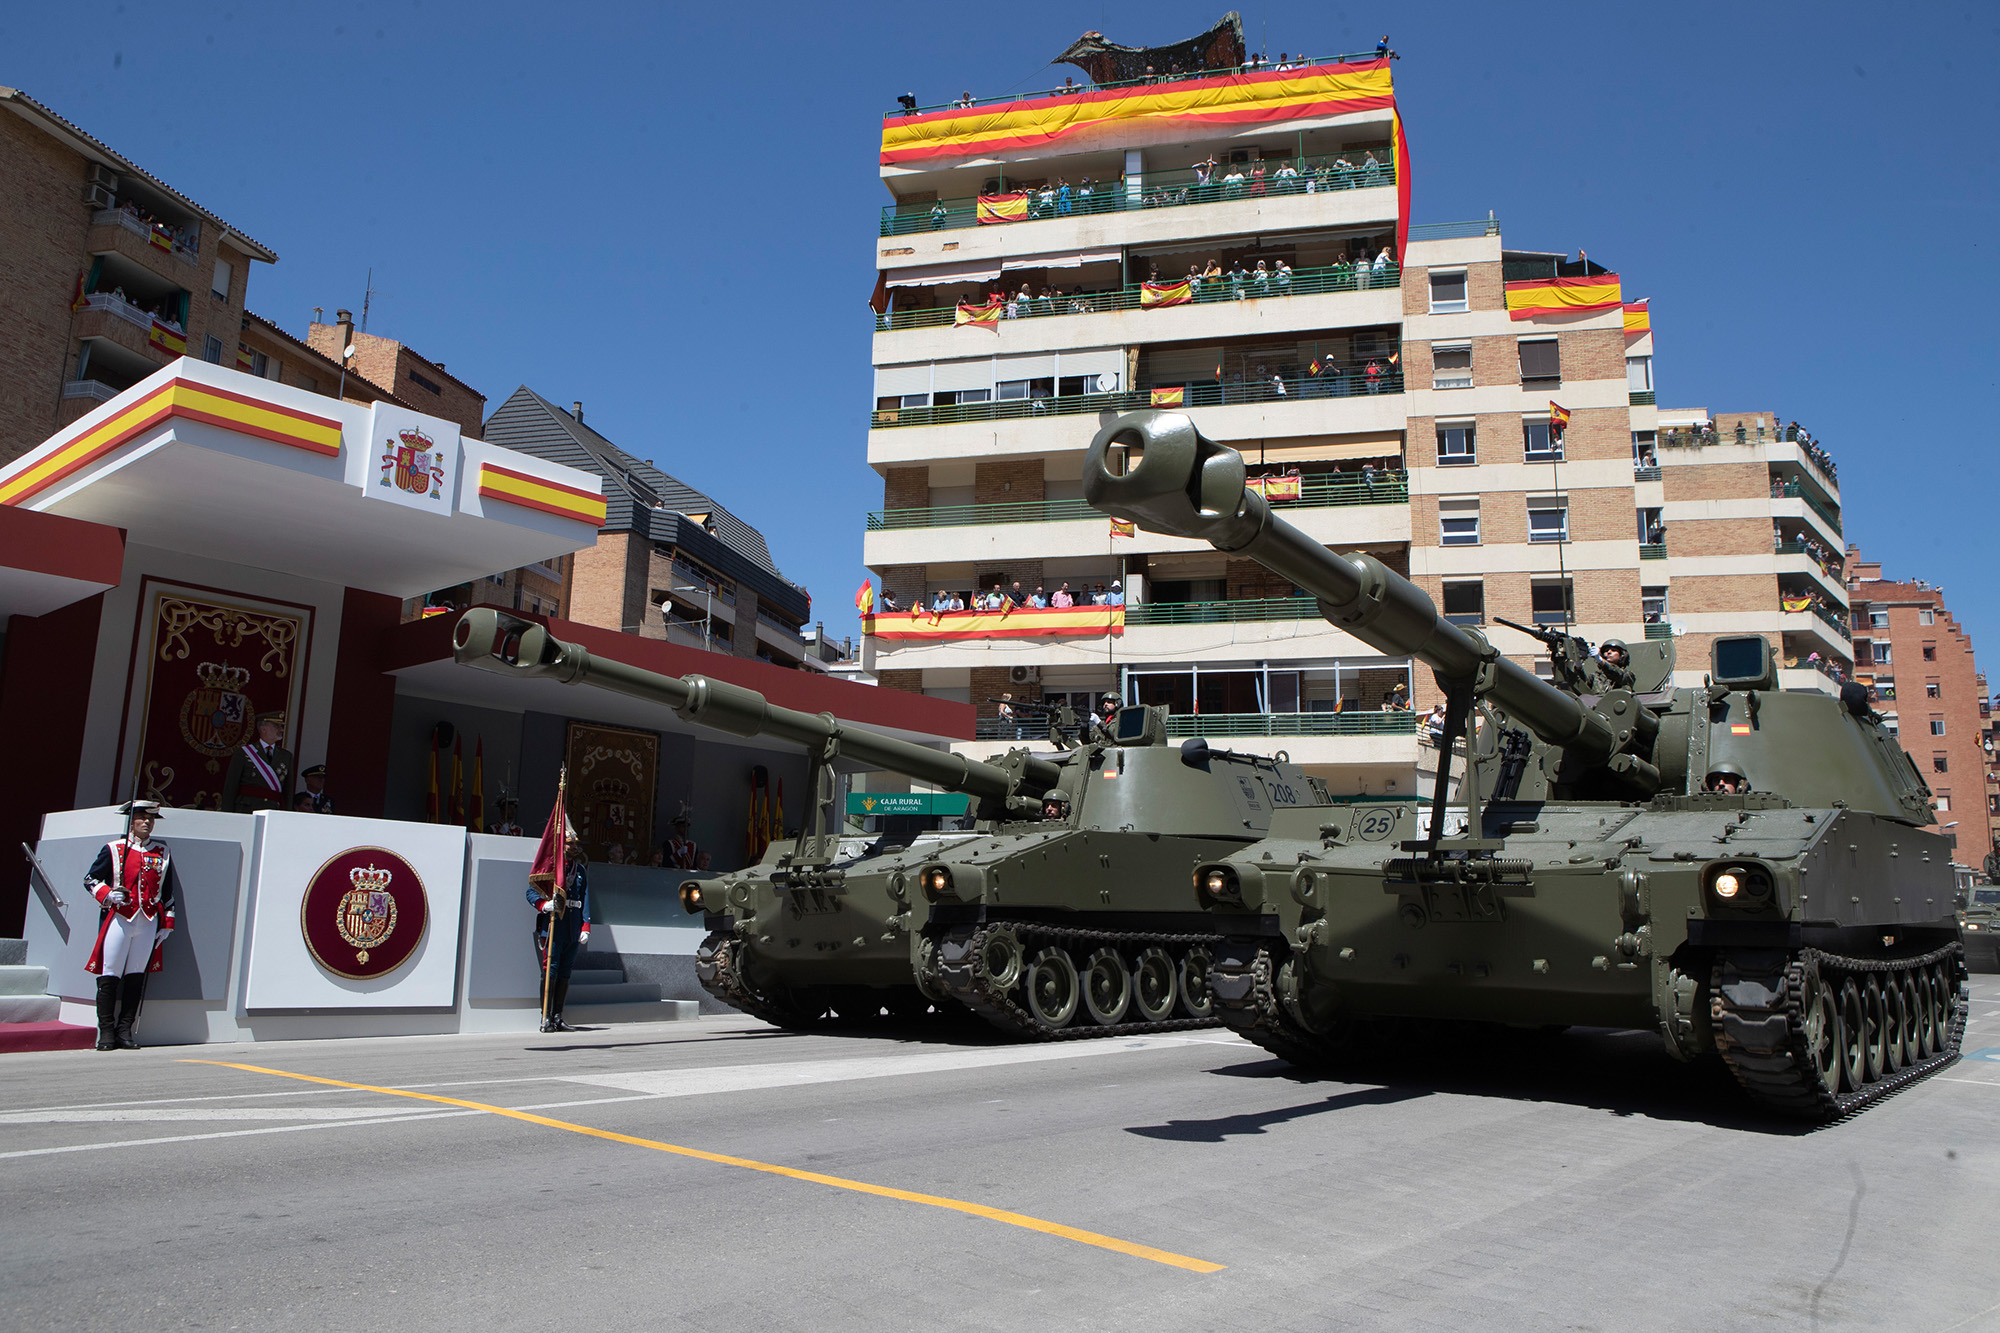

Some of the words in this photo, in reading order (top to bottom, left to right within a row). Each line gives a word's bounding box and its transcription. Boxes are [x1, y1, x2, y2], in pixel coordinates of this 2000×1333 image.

[1268, 782, 1296, 804] 208
[899, 798, 923, 806] RURAL
[1363, 817, 1390, 833] 25
